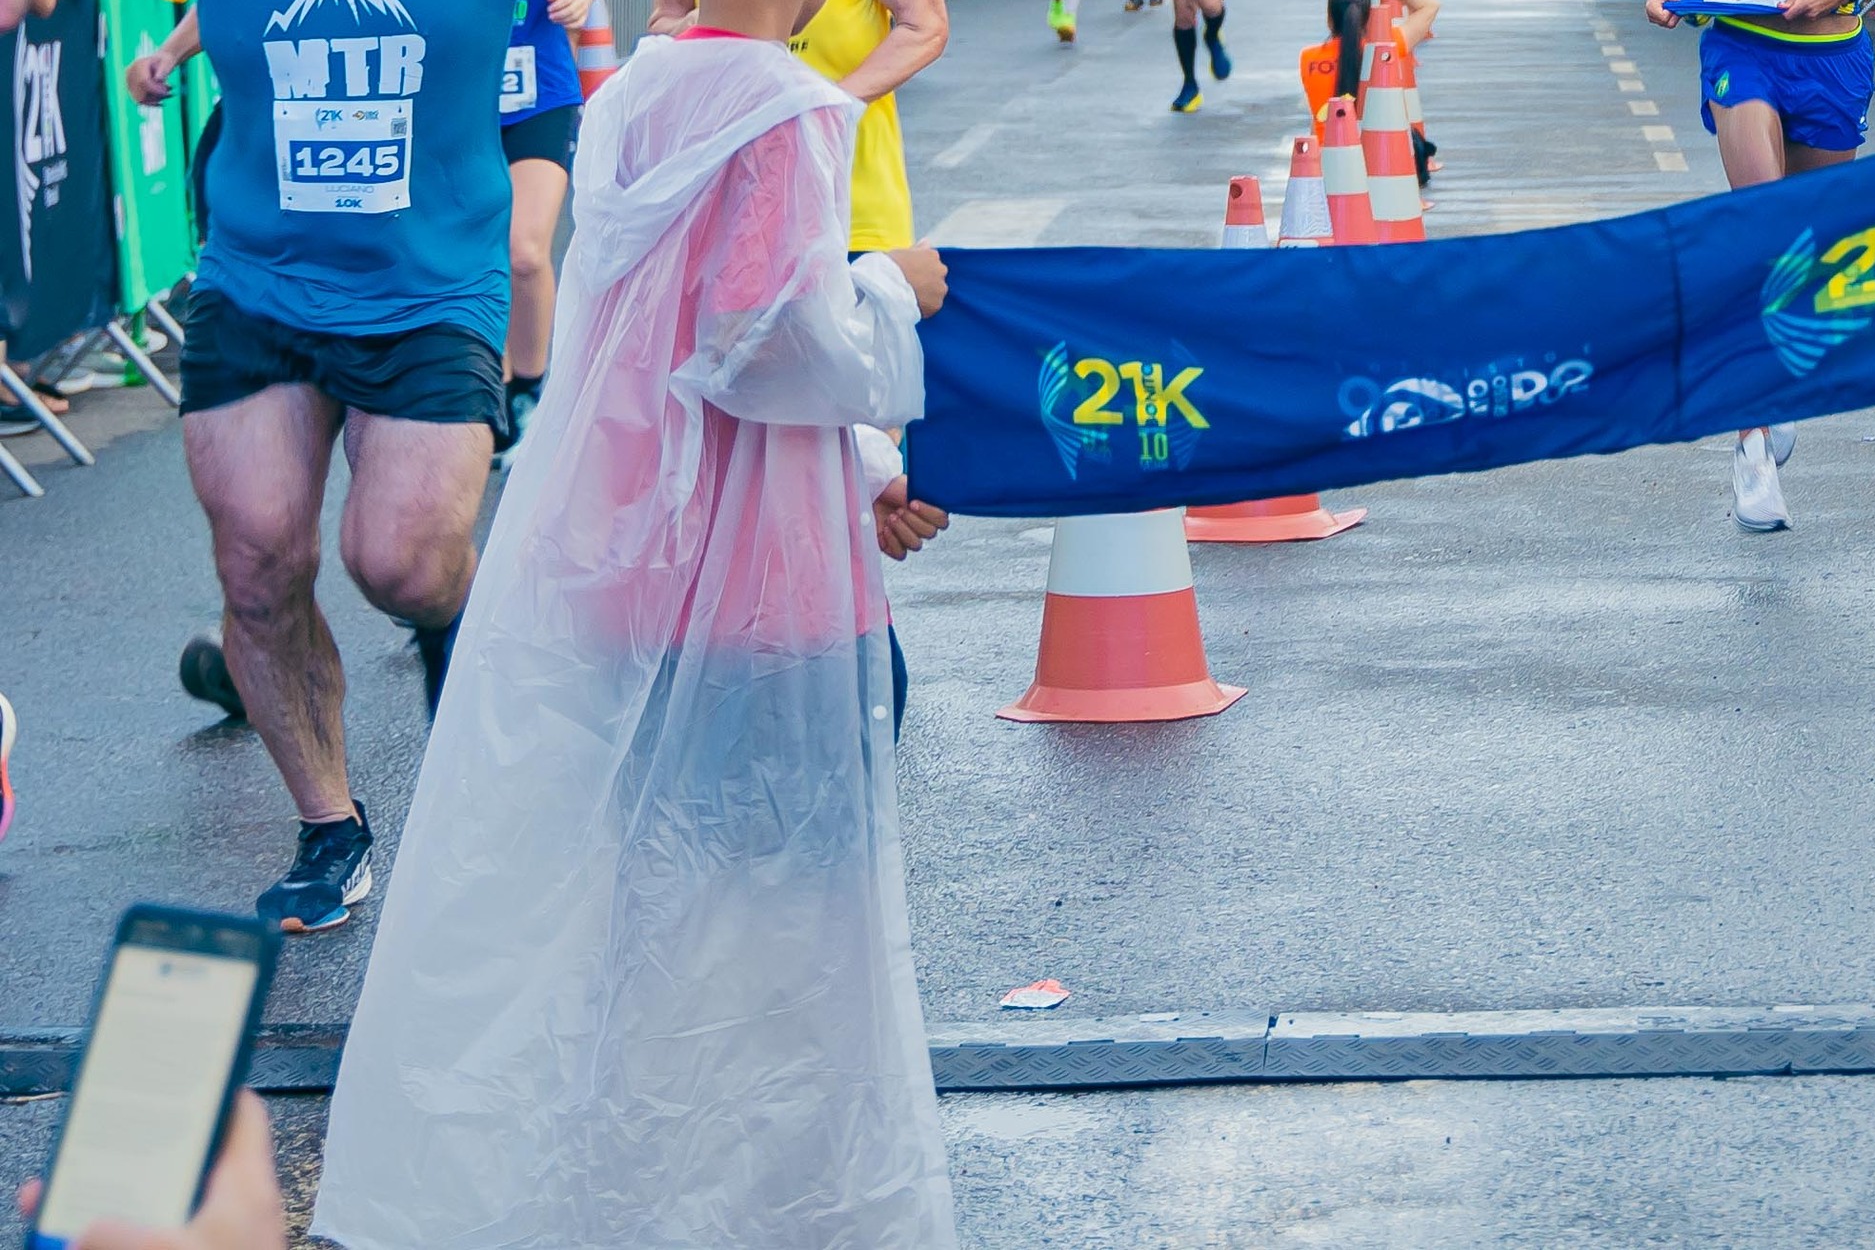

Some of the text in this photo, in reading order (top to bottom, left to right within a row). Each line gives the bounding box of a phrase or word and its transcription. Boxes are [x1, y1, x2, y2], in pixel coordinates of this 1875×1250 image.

[263, 34, 426, 99] MTR
[295, 145, 399, 177] 1245
[1073, 358, 1210, 428] 21K
[1139, 432, 1168, 460] 10
